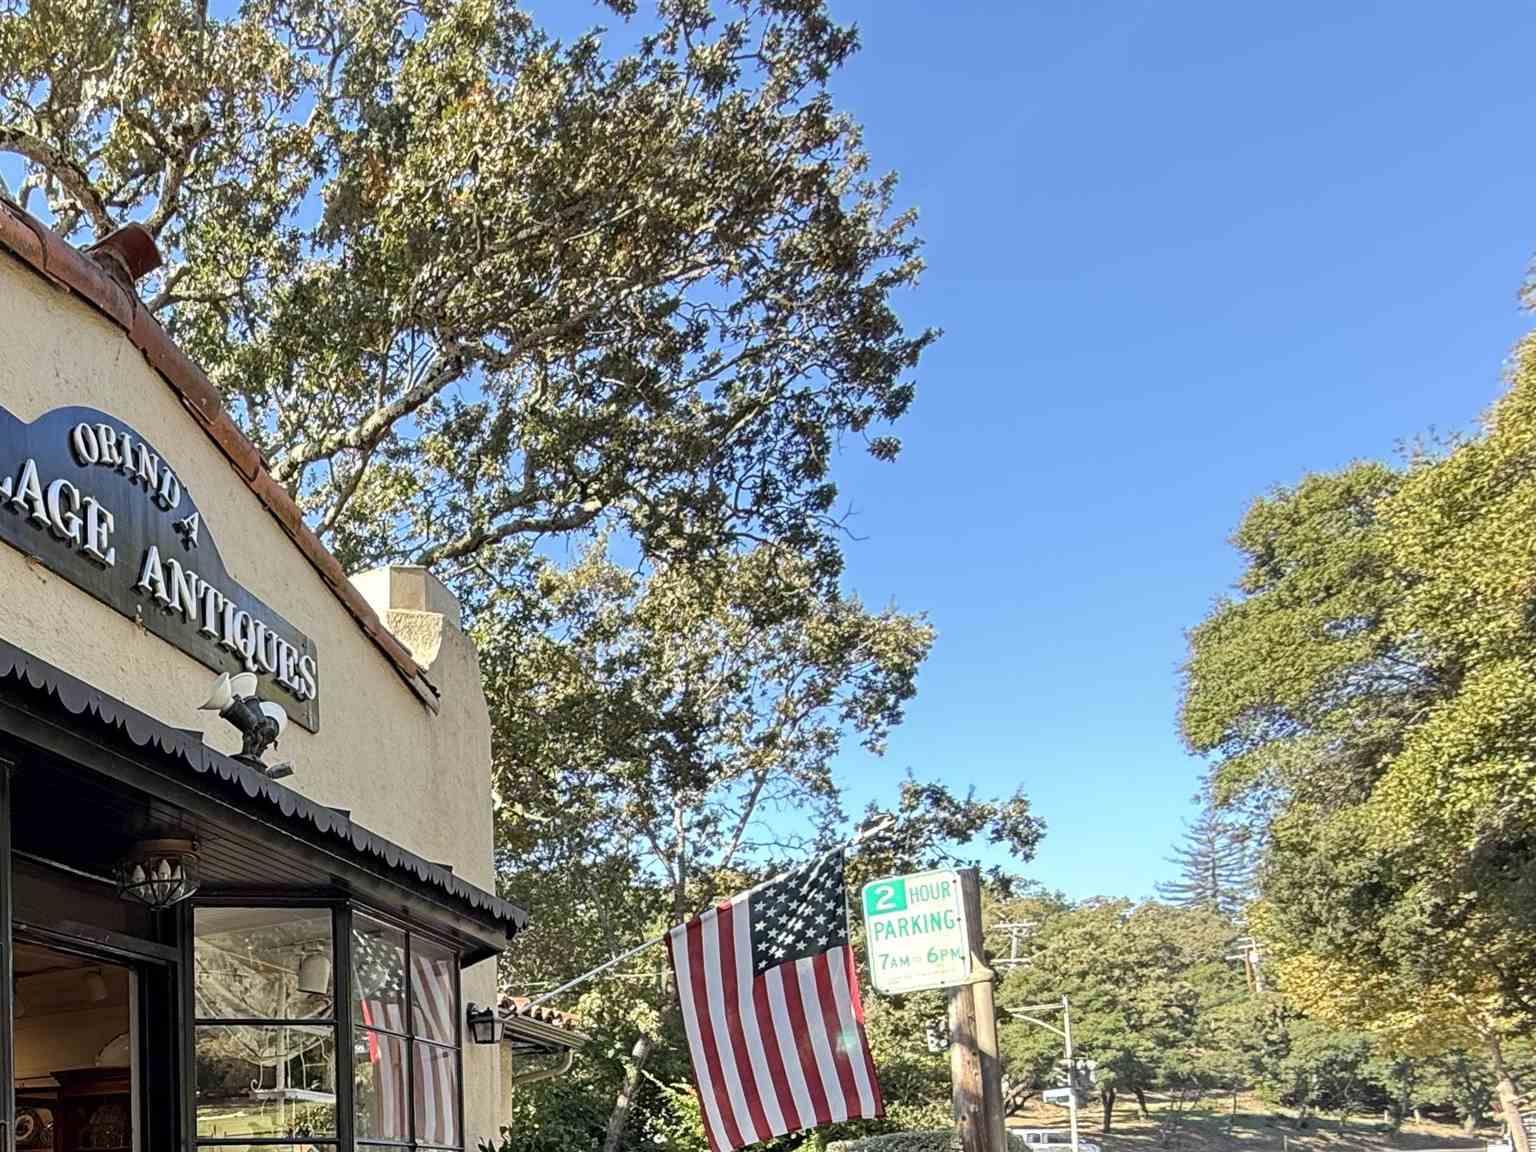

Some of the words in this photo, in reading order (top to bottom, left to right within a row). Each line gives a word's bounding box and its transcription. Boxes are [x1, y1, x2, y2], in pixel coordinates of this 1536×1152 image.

[73, 423, 201, 548] ORINDA
[137, 545, 317, 701] ANTIQUES
[874, 910, 955, 940] PARKING
[875, 885, 897, 910] 2
[909, 881, 951, 904] HOUR
